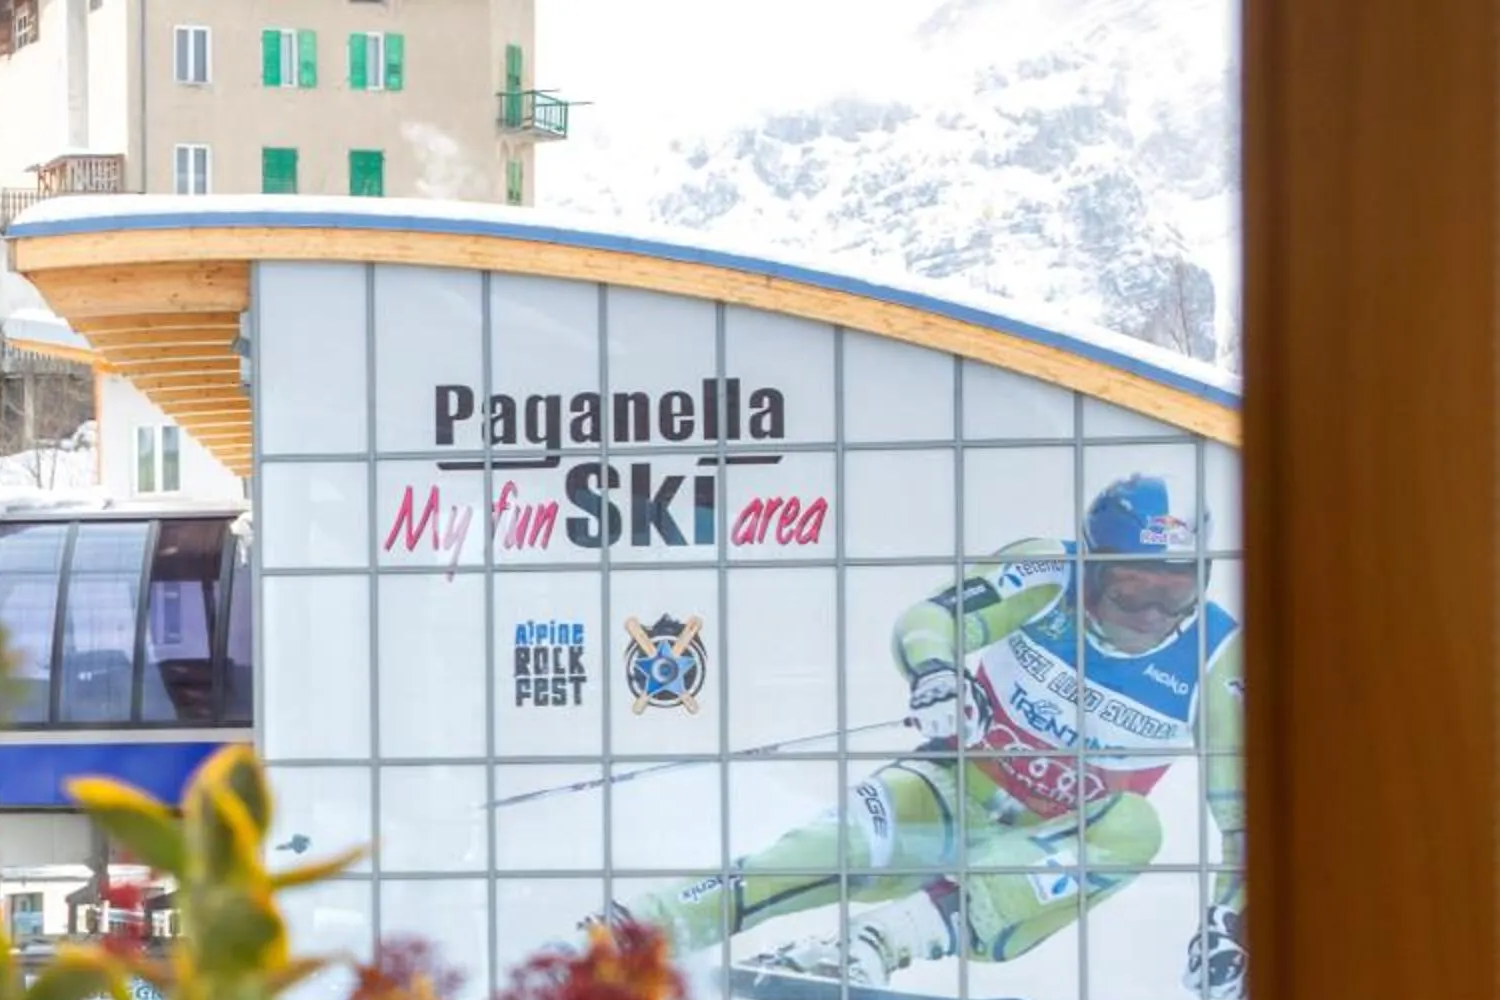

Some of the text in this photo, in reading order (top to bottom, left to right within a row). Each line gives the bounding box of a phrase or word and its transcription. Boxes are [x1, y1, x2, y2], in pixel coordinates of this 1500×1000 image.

[435, 377, 786, 468] Paganella
[384, 484, 474, 583] My
[488, 480, 561, 552] fun
[730, 494, 829, 547] area
[514, 645, 587, 677] ROCK
